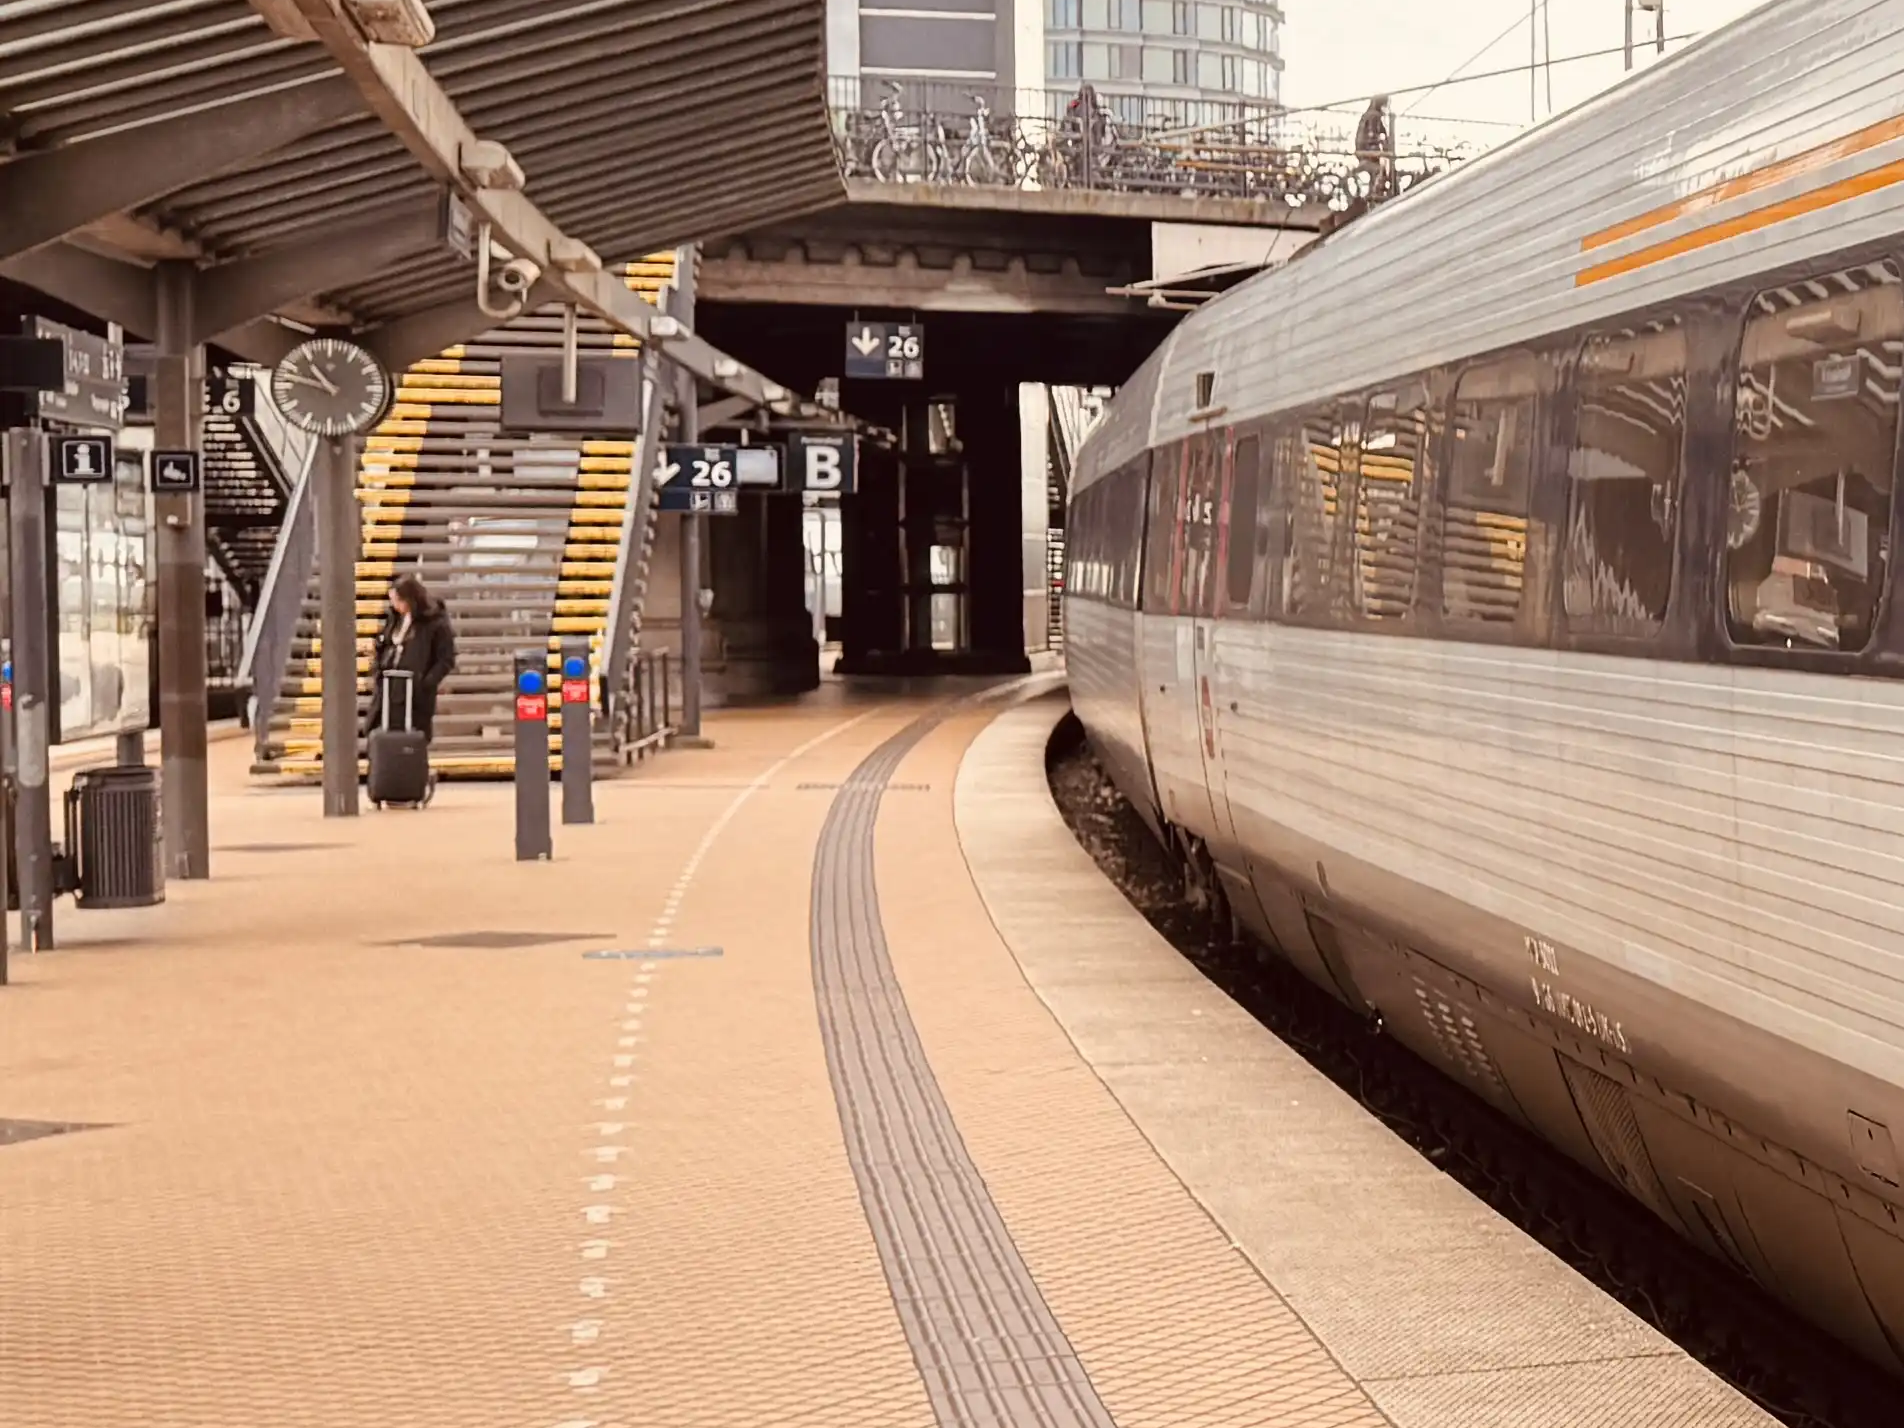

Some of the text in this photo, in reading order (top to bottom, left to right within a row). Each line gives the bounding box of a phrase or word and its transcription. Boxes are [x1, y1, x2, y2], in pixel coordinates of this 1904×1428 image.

[888, 335, 920, 359] 26
[691, 459, 732, 487] 26
[806, 445, 842, 489] B
